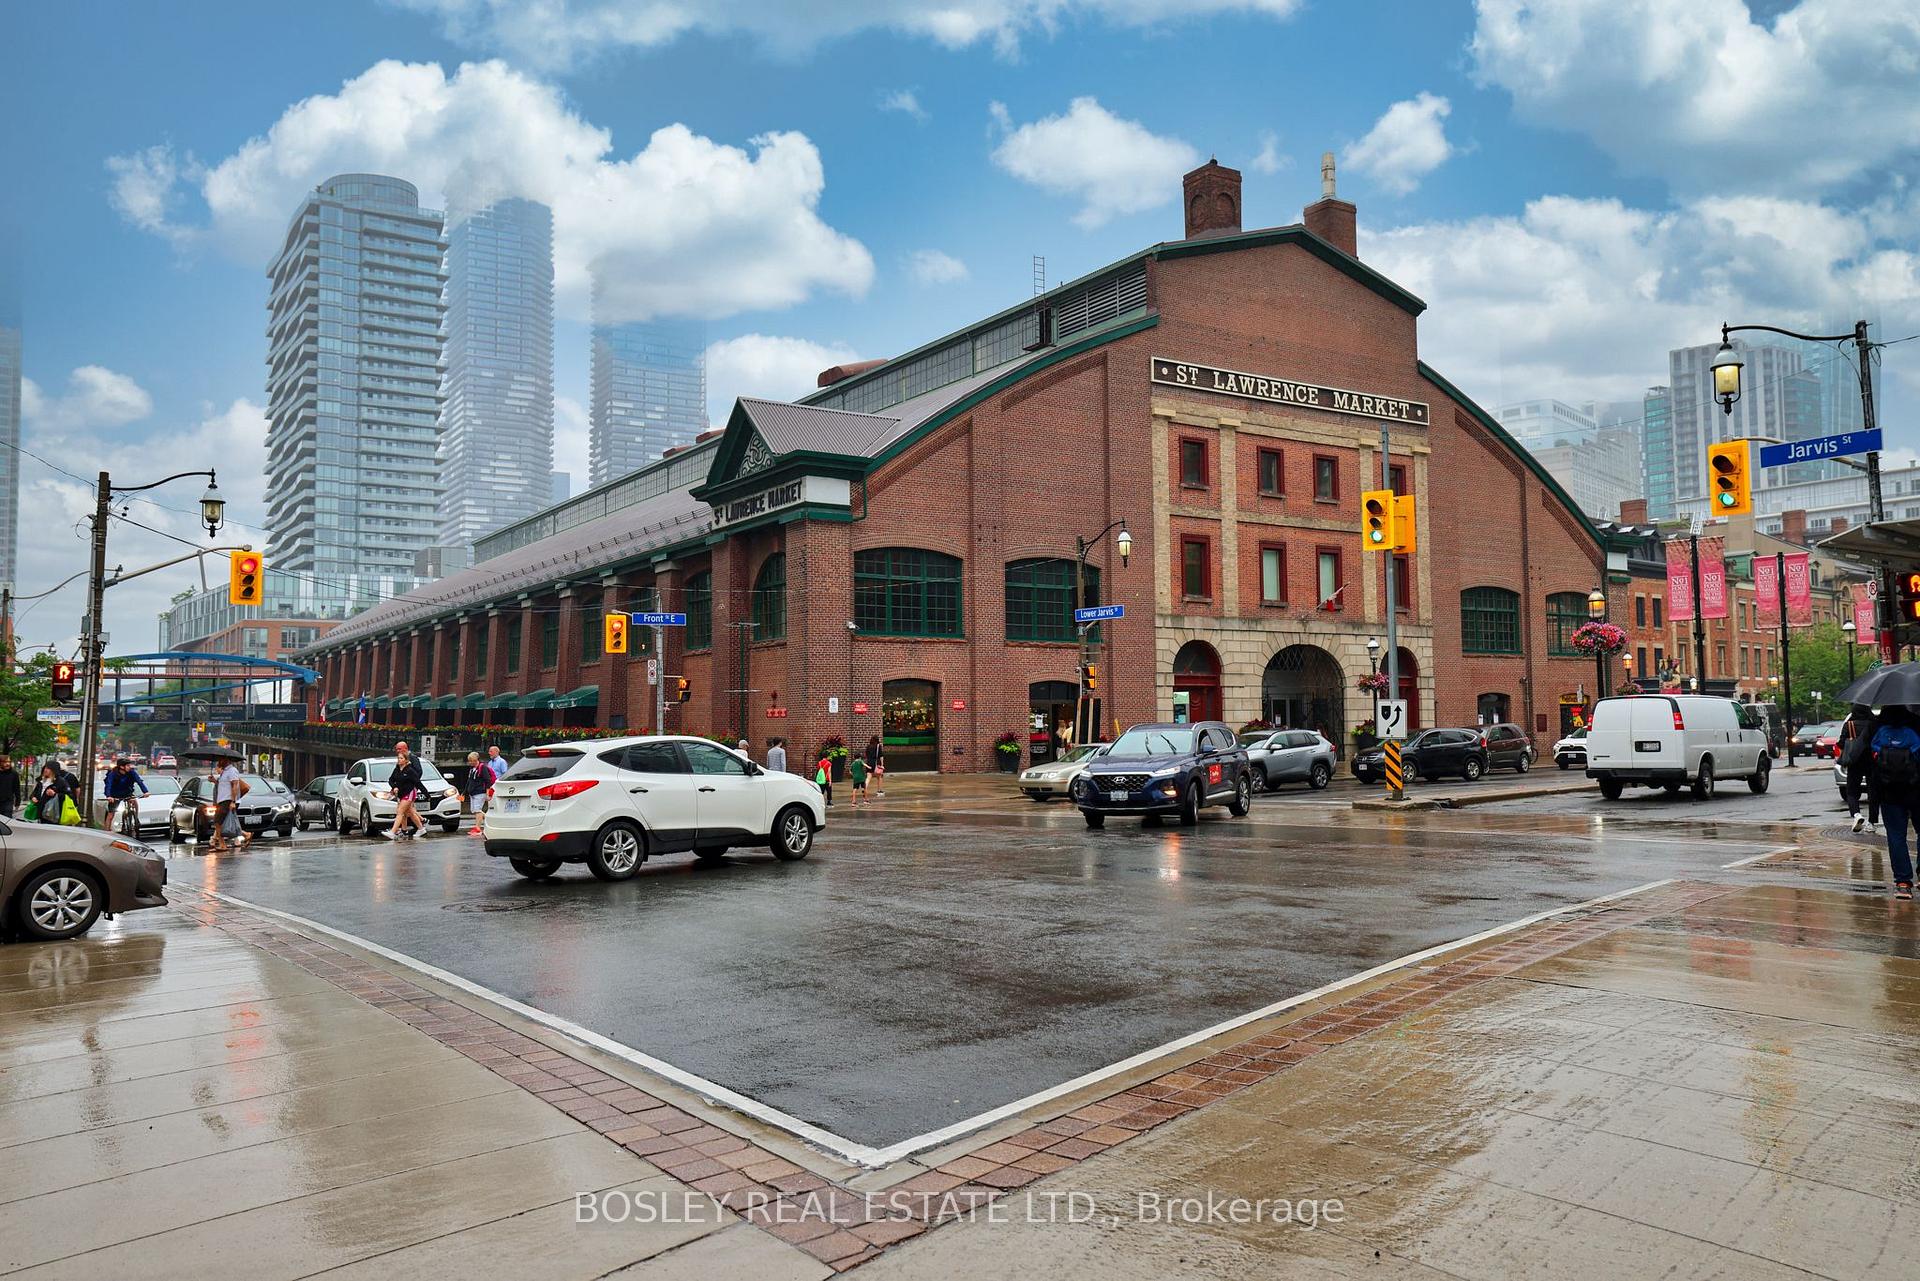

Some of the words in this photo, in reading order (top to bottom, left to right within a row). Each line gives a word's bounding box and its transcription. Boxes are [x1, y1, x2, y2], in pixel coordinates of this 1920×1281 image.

[1213, 371, 1319, 405] LAWRENCE
[1333, 391, 1410, 419] MARKET
[1788, 439, 1838, 459] Jarvis
[1842, 435, 1852, 444] St
[726, 494, 765, 522] LAWRENCE
[768, 482, 802, 509] MARKET
[643, 614, 664, 622] Front
[670, 615, 676, 623] E
[1080, 610, 1096, 618] Lower
[1097, 607, 1114, 617] Jarvis
